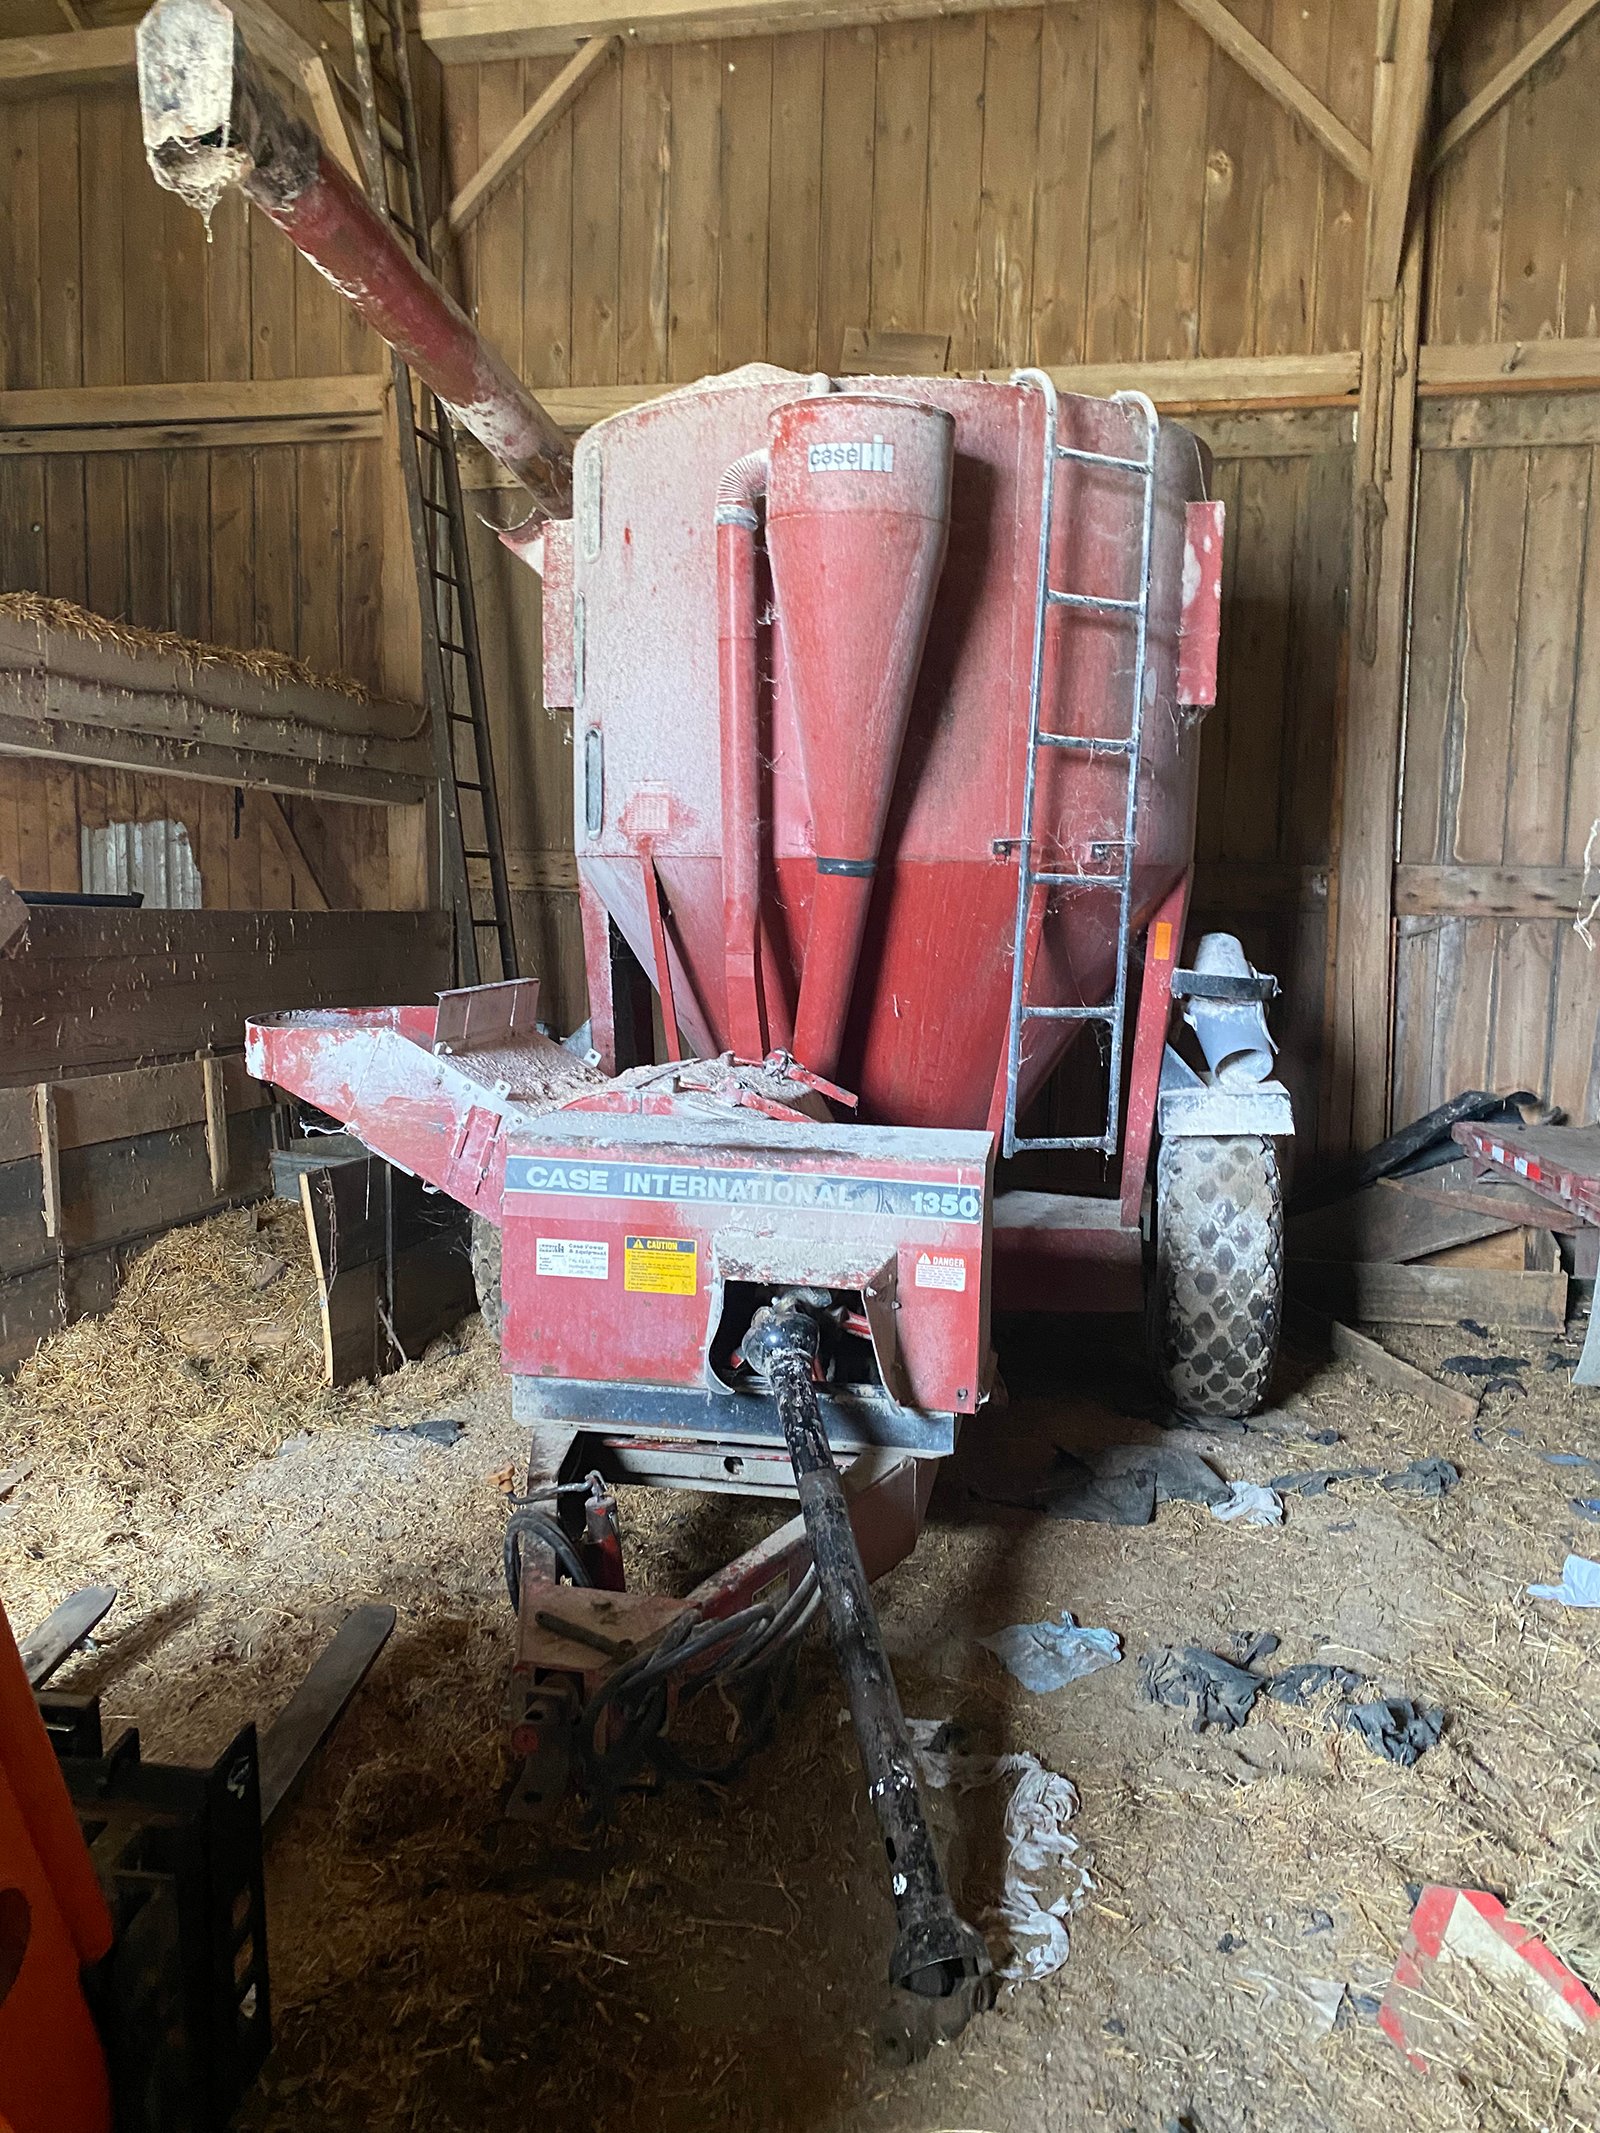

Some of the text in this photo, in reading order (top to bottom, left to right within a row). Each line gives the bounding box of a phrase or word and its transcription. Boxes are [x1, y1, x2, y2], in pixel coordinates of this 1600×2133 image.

[526, 1166, 979, 1218] CASE INTERNATIONAL 1350
[646, 1240, 678, 1251] CAUTION
[932, 1256, 965, 1268] DANGER
